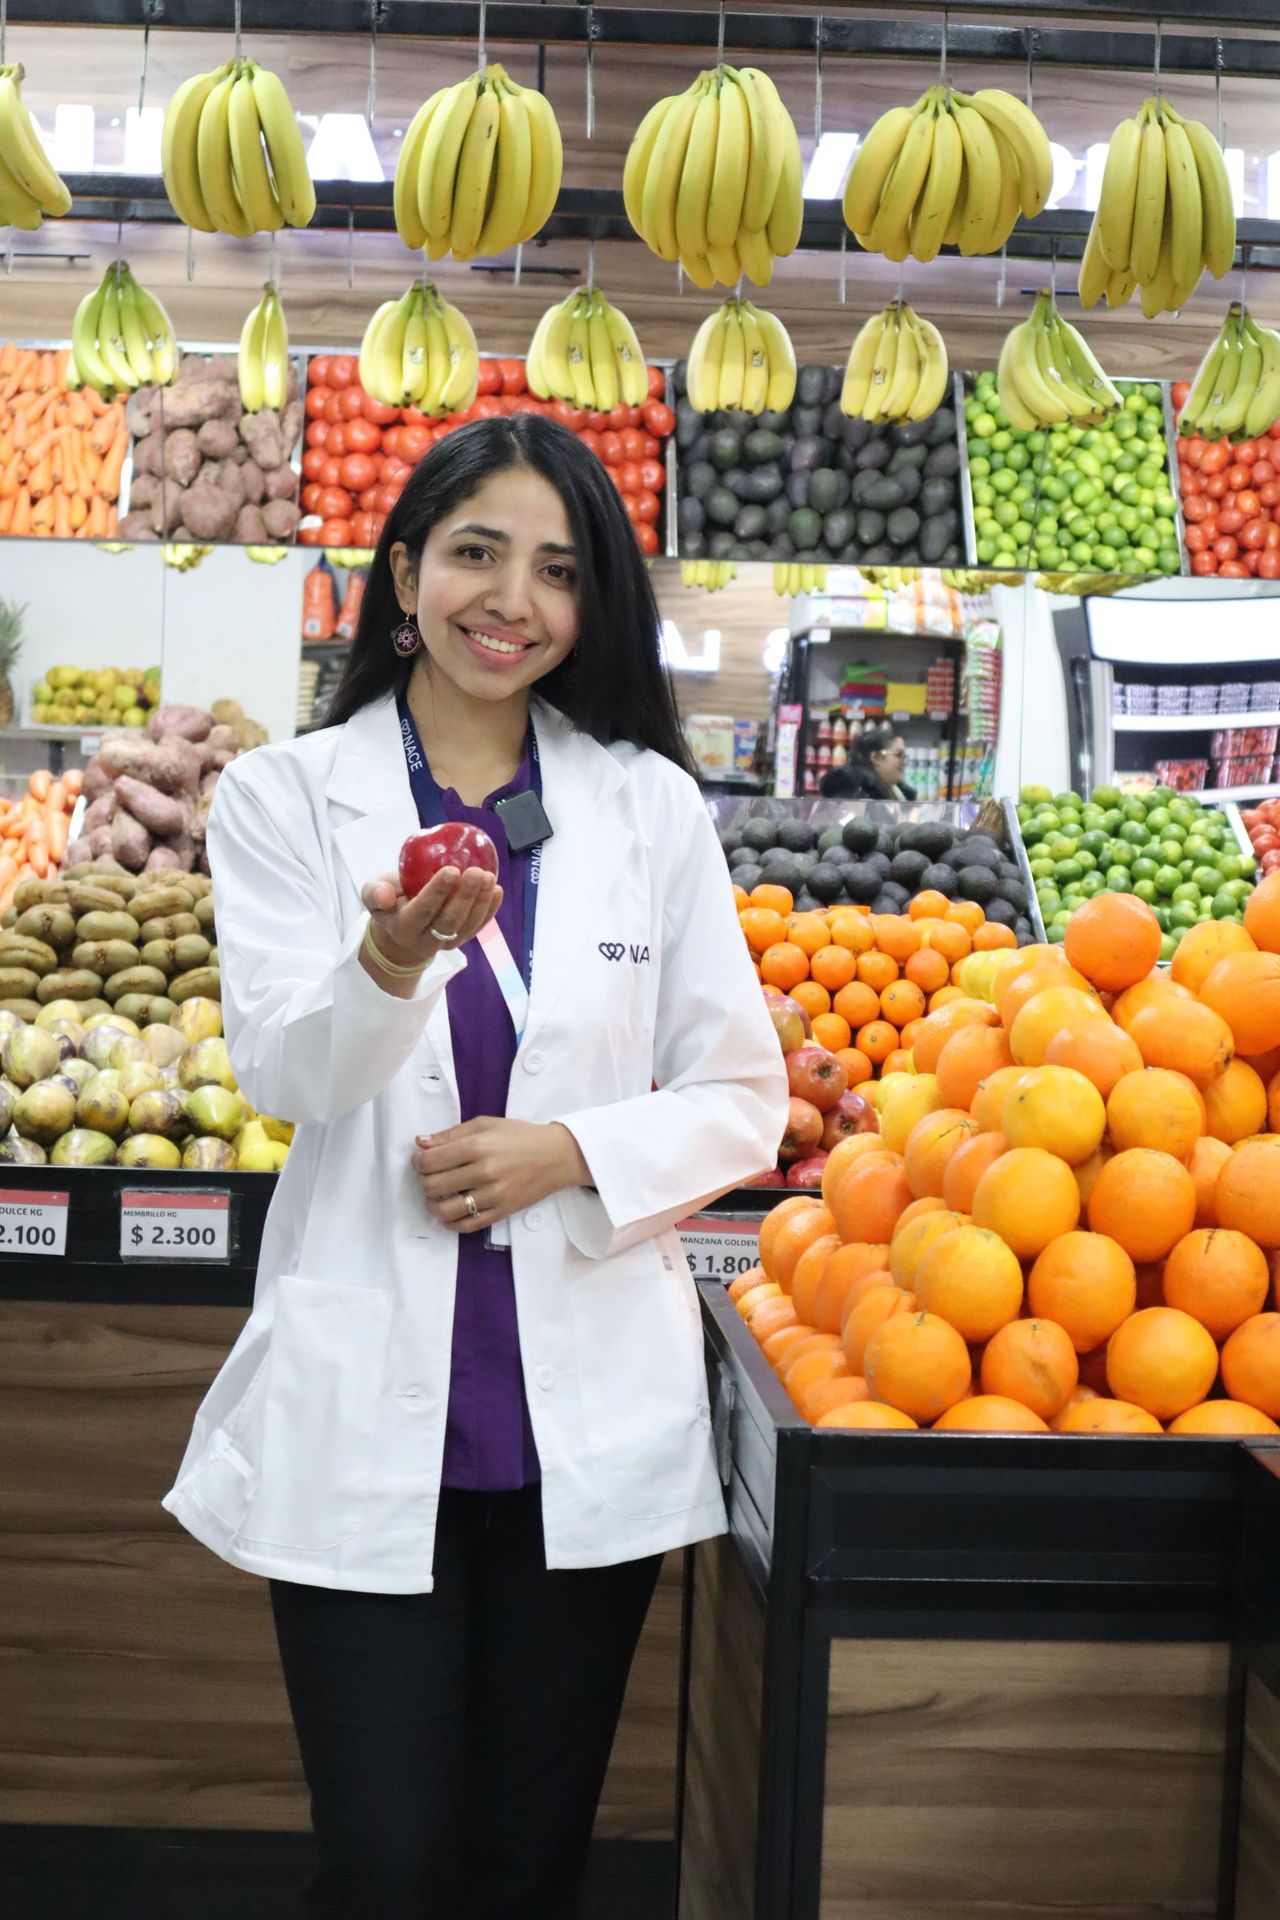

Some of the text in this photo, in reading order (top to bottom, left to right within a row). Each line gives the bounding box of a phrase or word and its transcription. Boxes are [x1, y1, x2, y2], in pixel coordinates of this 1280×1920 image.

[403, 735, 423, 772] NACE
[0, 1207, 43, 1217] DULCE KG
[123, 1210, 166, 1218] MEMBRILLO
[131, 1224, 216, 1247] $ 2.300
[680, 1237, 758, 1247] MANZANA GOLDEN
